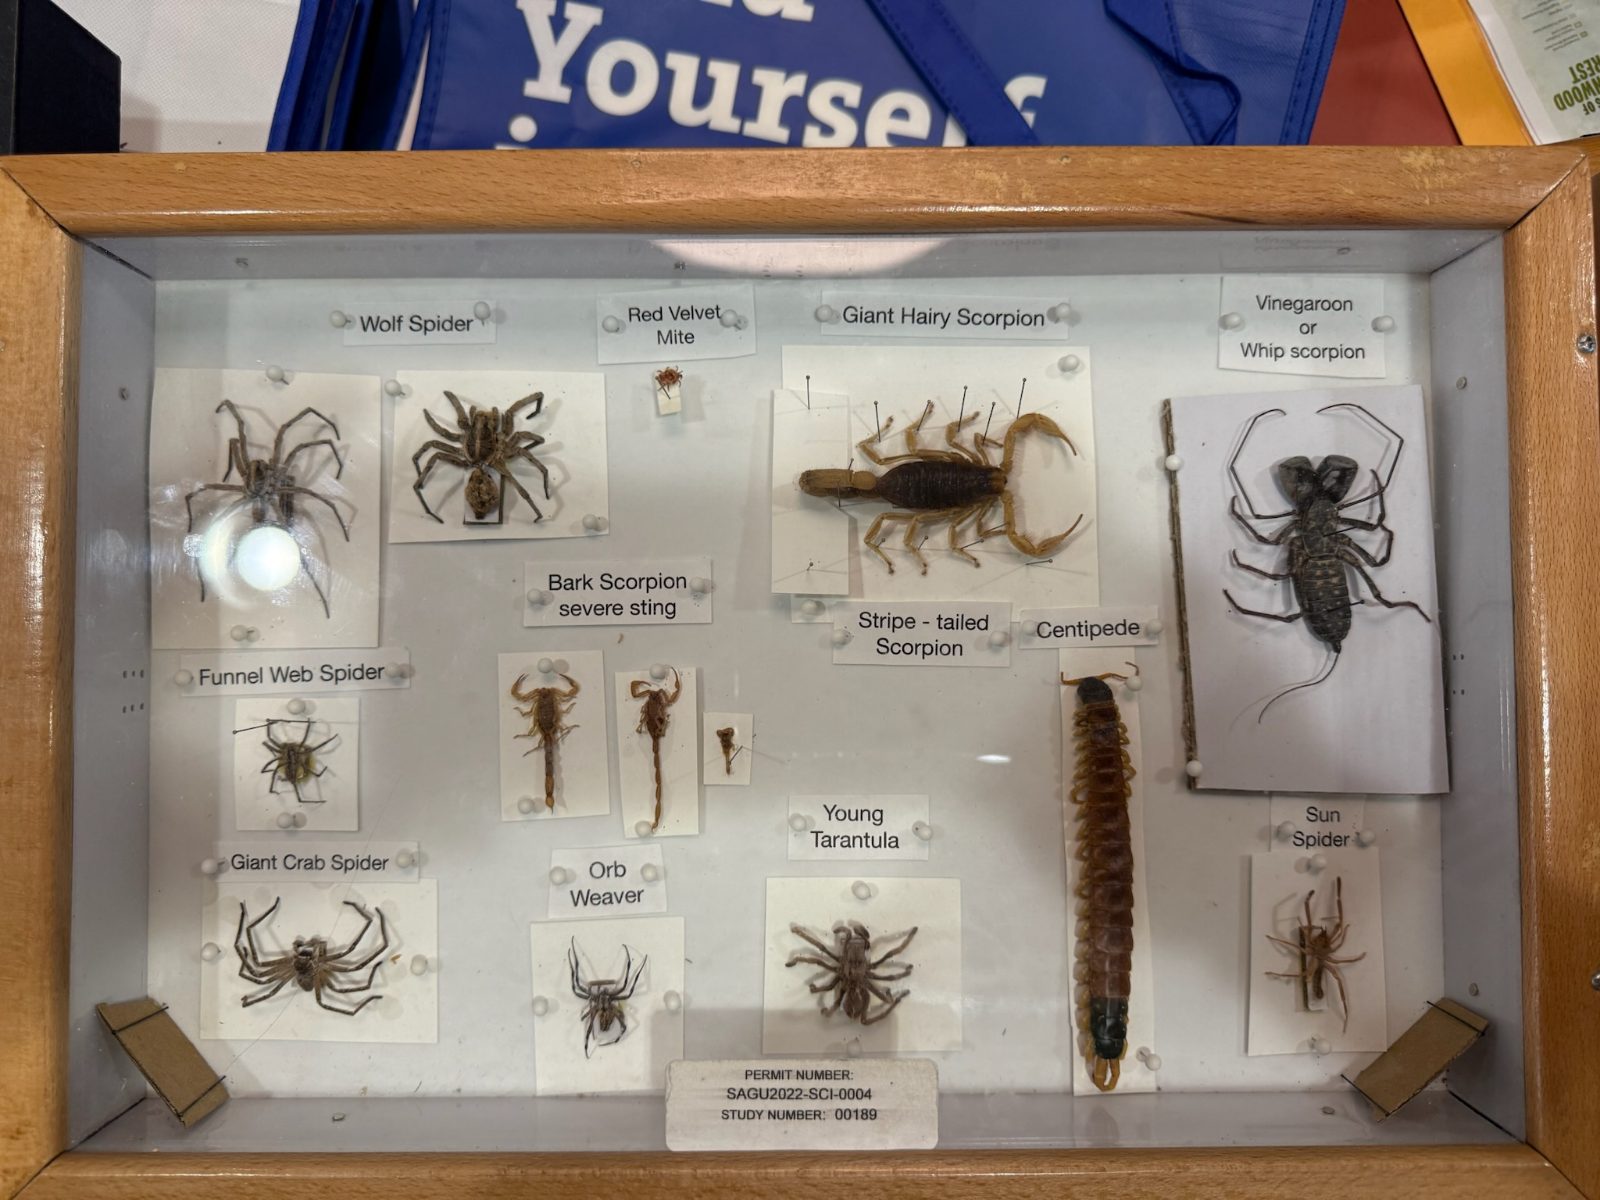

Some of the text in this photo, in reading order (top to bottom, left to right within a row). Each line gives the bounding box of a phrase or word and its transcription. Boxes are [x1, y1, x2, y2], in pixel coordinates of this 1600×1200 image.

[515, 0, 1047, 147] Yourse
[1582, 100, 1597, 116] OF
[628, 304, 722, 323] Red Velvet
[1255, 294, 1353, 315] Vinegaroon
[359, 314, 474, 336] Wolf Spider
[842, 305, 1045, 331] Giant Hairy Scorpion
[1299, 322, 1318, 335] or
[656, 329, 695, 345] Mite
[1239, 342, 1366, 363] Whip scorpion
[548, 572, 687, 594] Bark Scorpion
[559, 598, 677, 620] severe sting
[858, 611, 917, 634] Stripe
[936, 613, 989, 631] tailed
[1036, 618, 1141, 641] Centipede
[876, 637, 963, 660] Scorpion
[198, 663, 386, 687] Funnel Web Spider
[822, 803, 884, 827] Young
[1306, 805, 1341, 823] Sun
[809, 830, 900, 849] Tarantula
[1293, 830, 1349, 849] Spider
[230, 853, 390, 874] Giant Crab Spider
[589, 860, 627, 880] Orb
[569, 888, 645, 908] Weaver
[744, 1069, 854, 1081] PERMIT NUMBER:
[726, 1087, 873, 1101] SAGU2022-SCI-0004
[721, 1108, 878, 1121] STUDY NUMBER: 00189
